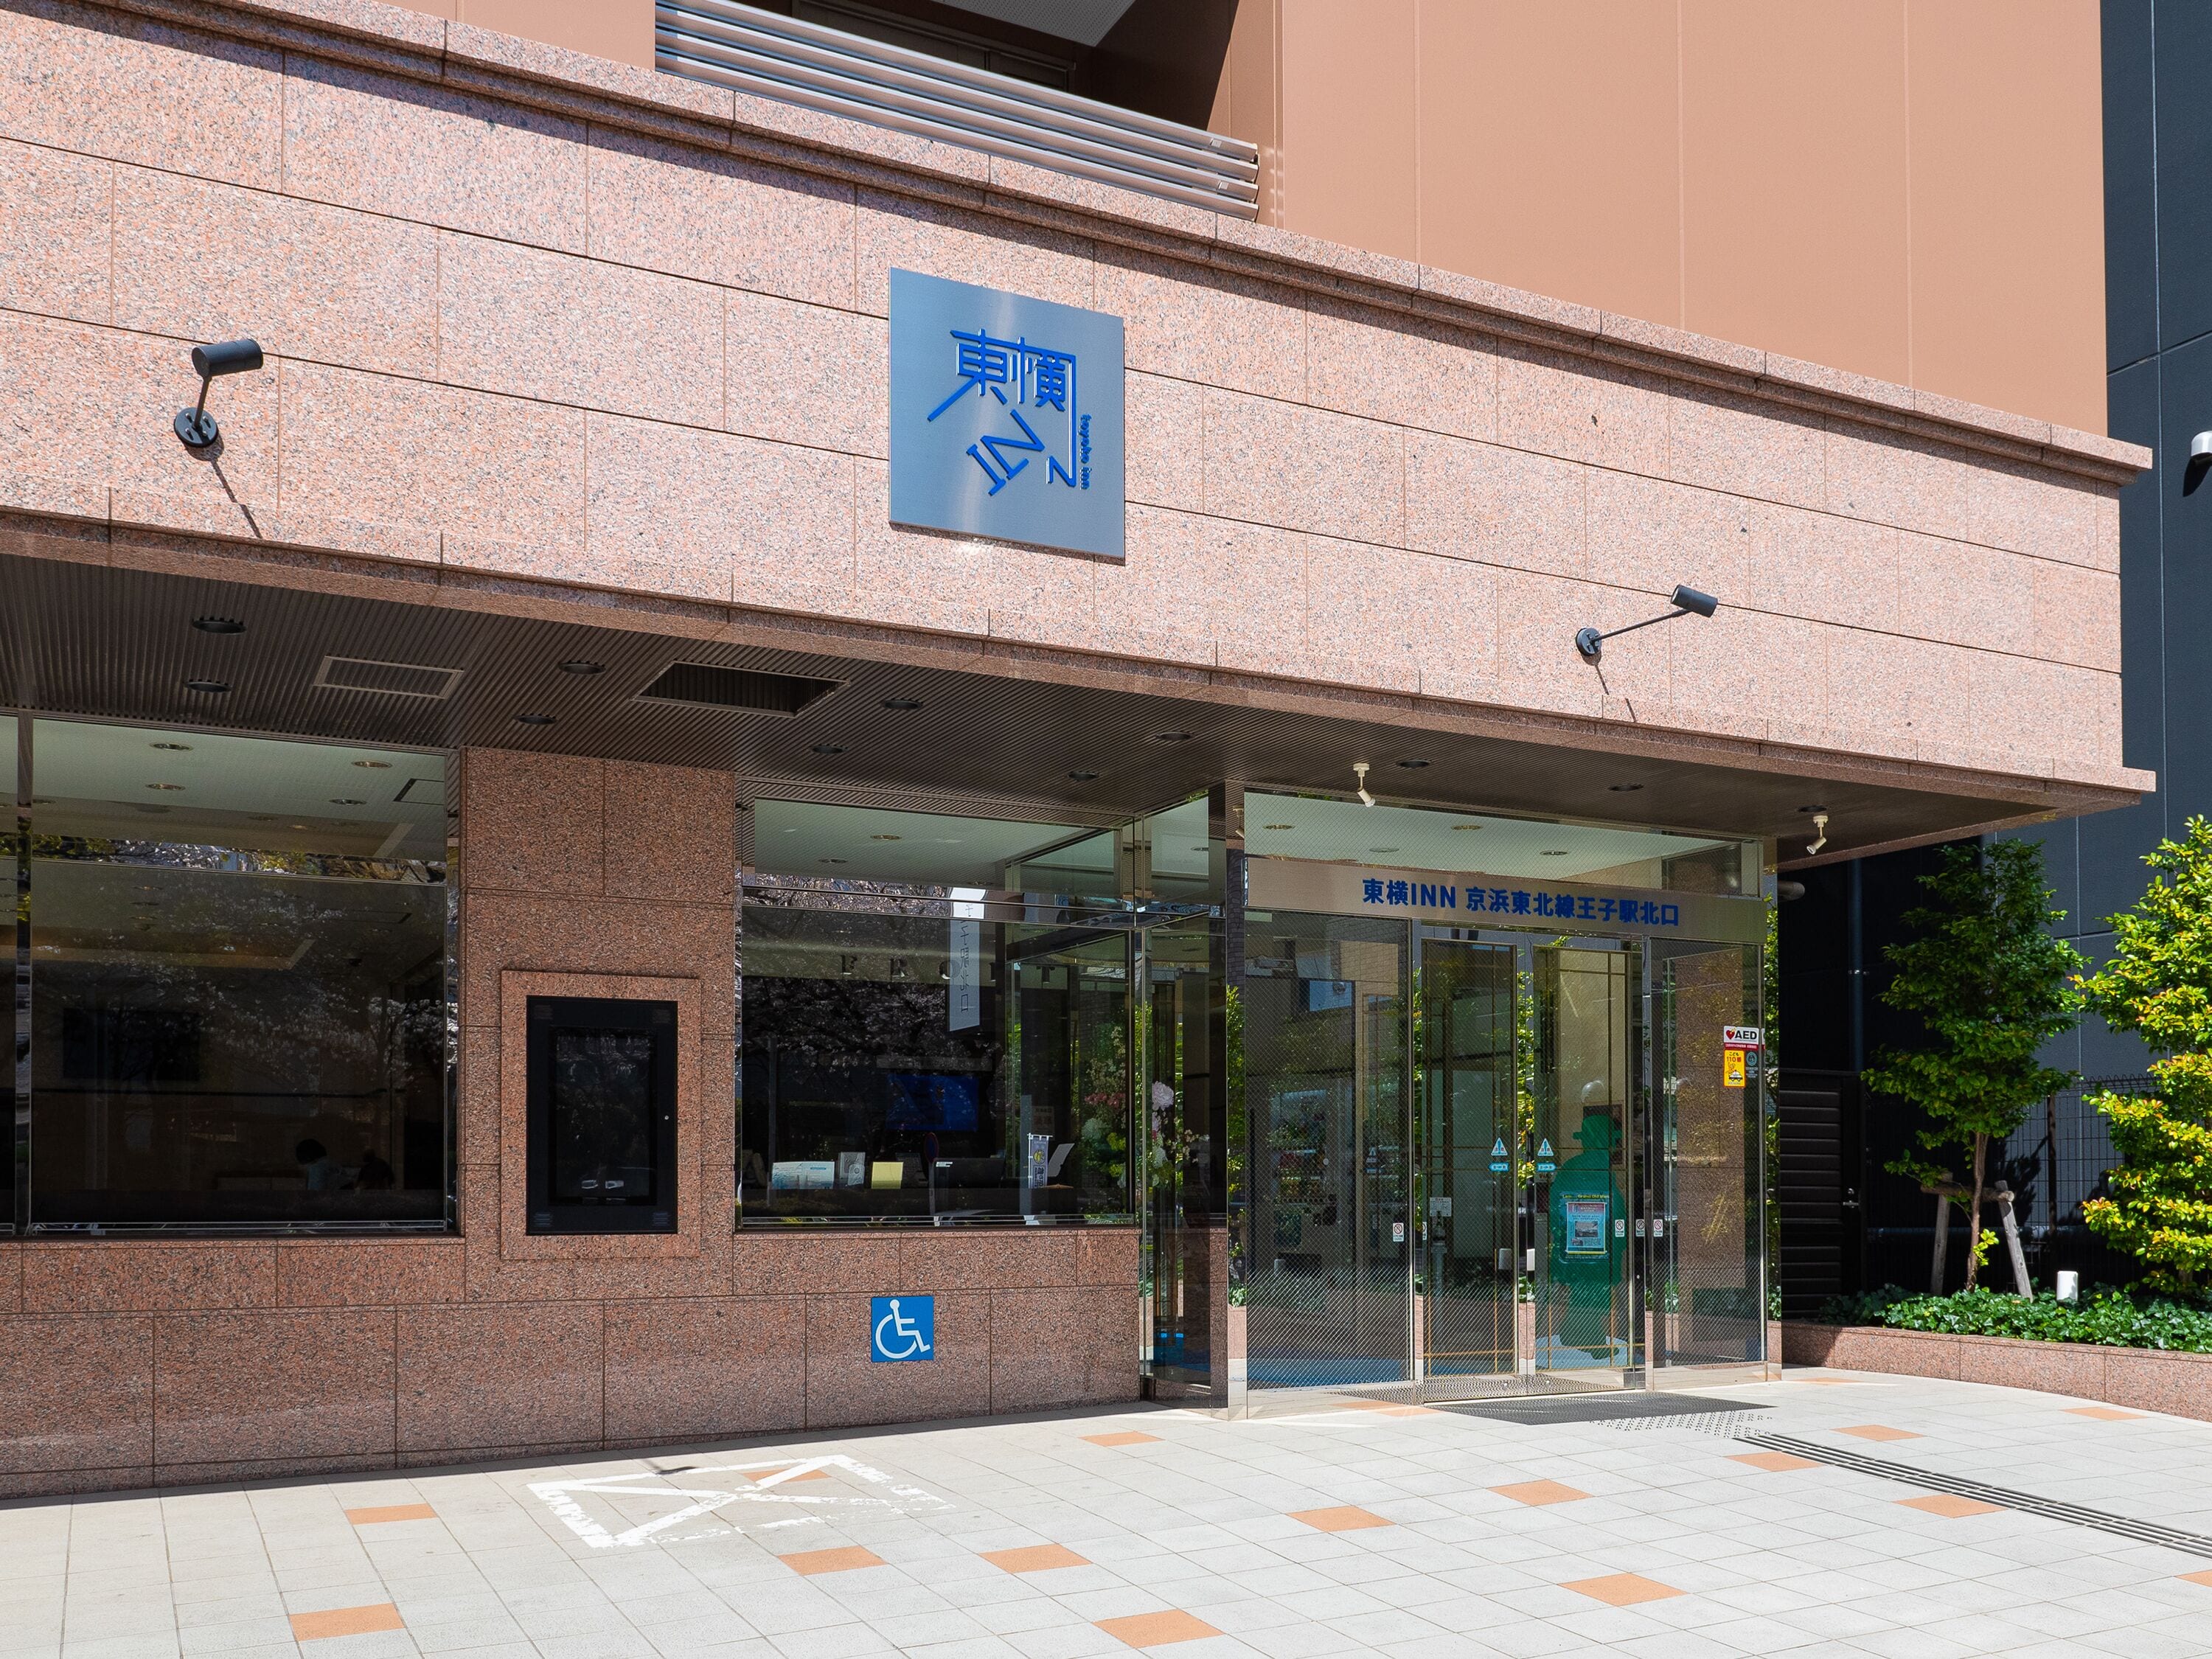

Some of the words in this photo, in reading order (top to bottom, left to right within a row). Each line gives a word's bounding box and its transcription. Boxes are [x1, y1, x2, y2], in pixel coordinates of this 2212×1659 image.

[1361, 877, 1457, 909] 東横INN
[1464, 886, 1680, 927] 京浜東北線王子駅北口
[1734, 1030, 1758, 1040] AED
